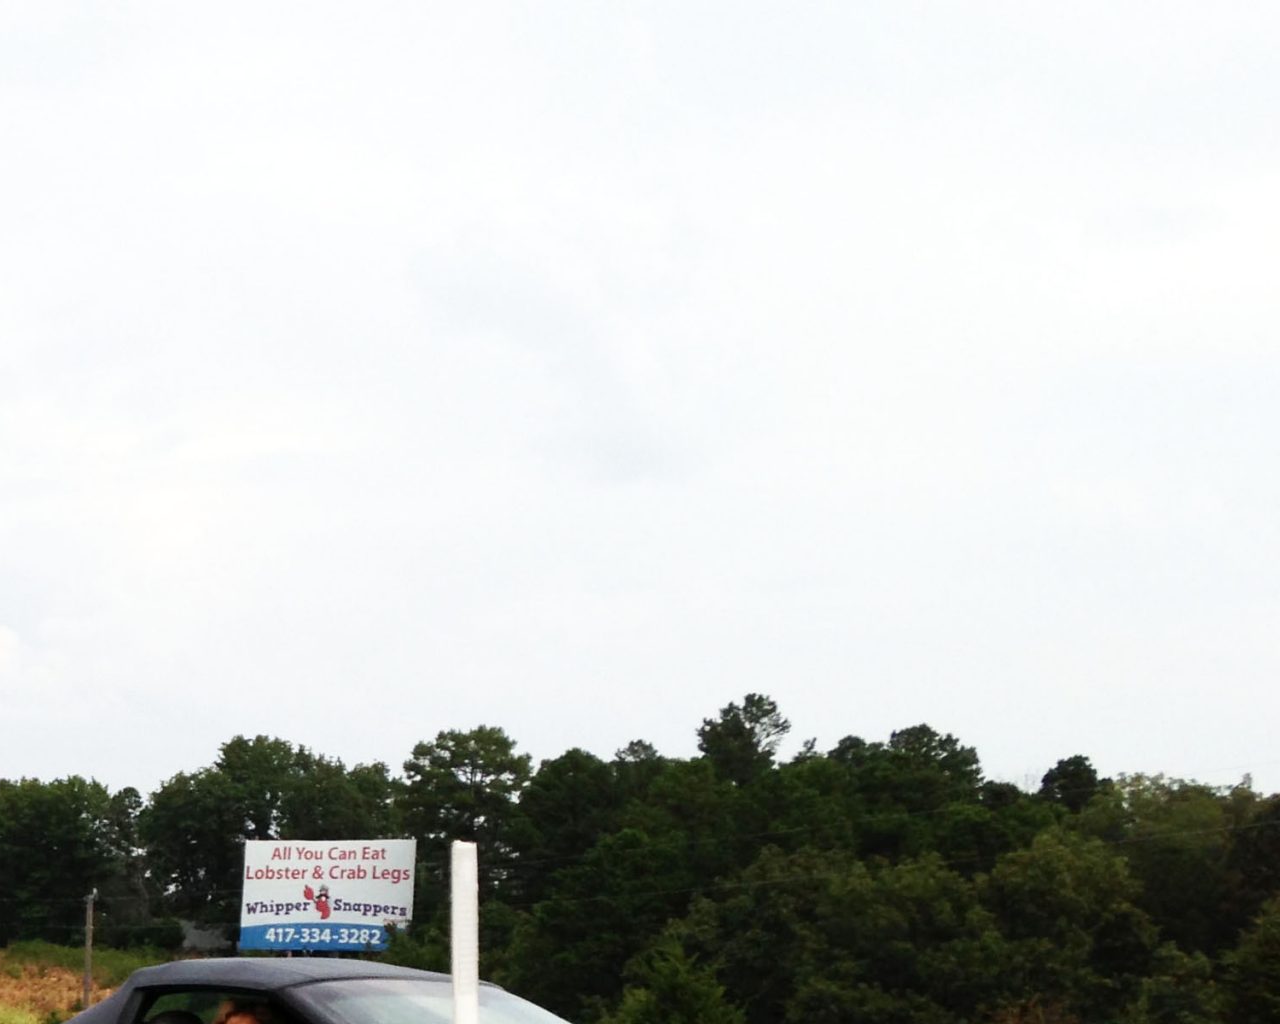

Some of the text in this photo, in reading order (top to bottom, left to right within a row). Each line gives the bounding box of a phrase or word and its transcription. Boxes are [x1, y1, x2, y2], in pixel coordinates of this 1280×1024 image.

[271, 846, 387, 860] All You Can Eat
[246, 865, 410, 884] Lobster & Crab Legs
[246, 898, 407, 917] Whipper Snappers
[265, 927, 381, 944] 417-334-3282
